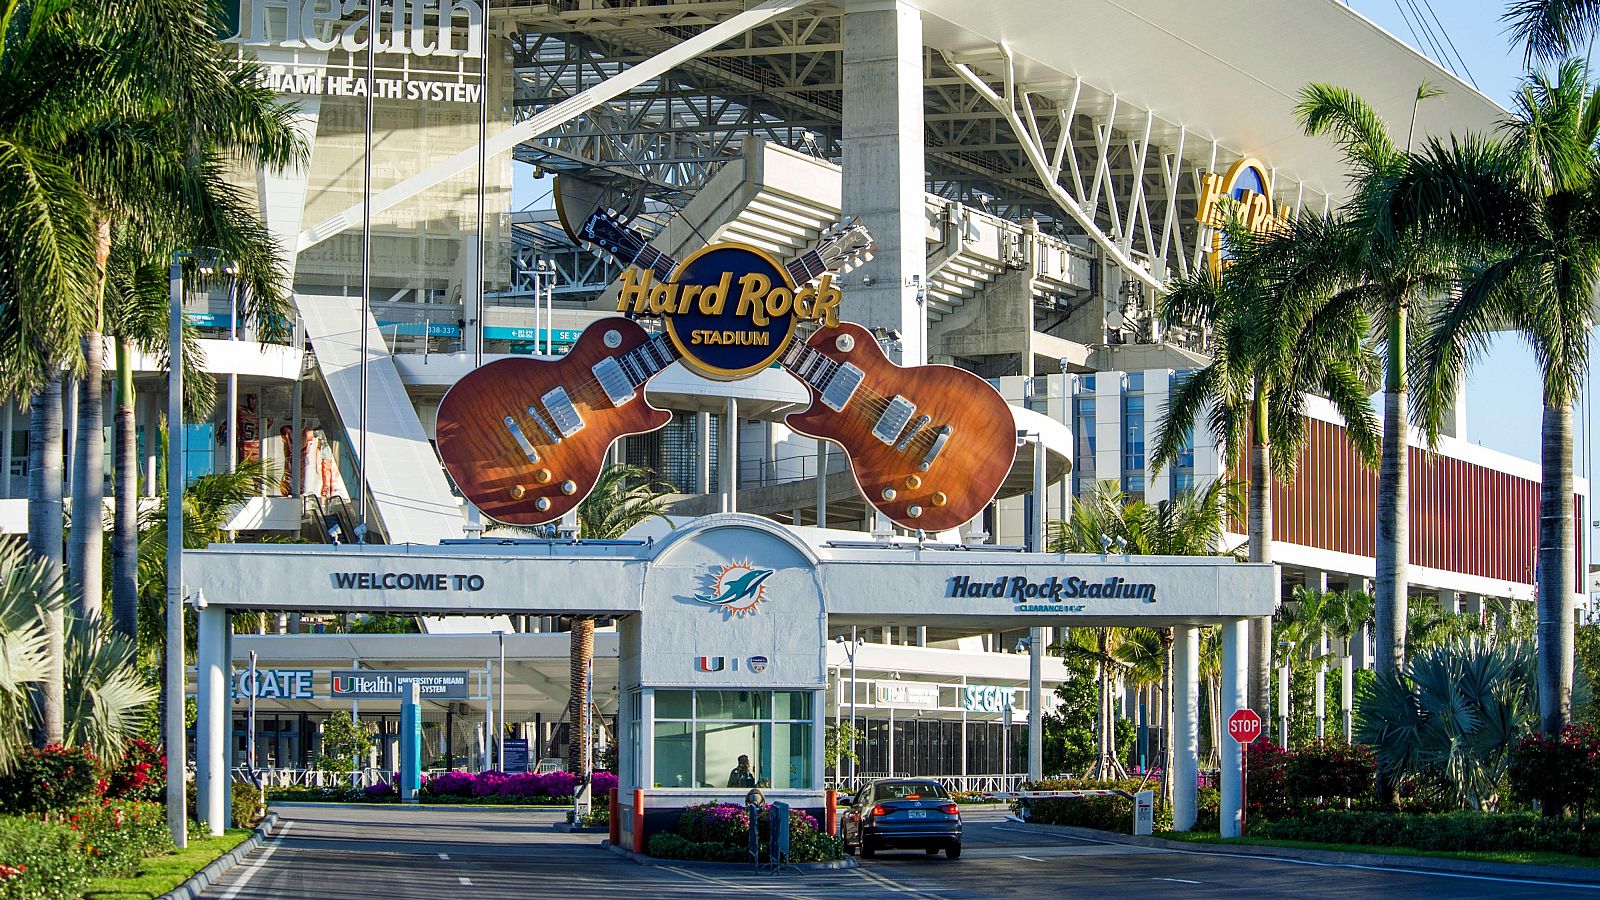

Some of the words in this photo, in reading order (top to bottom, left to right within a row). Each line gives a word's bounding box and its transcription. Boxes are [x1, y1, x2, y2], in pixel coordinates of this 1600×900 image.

[257, 72, 322, 96] MIAMI
[327, 75, 402, 99] HEALTH
[407, 80, 482, 103] SYSTEM
[617, 267, 733, 315] Hard
[735, 272, 843, 328] Rock
[559, 331, 570, 339] SE
[690, 329, 770, 346] STADIUM
[334, 572, 448, 591] WELCOME
[454, 574, 485, 592] TO
[951, 576, 1009, 598] Hard
[1010, 576, 1063, 603] Rock
[1064, 576, 1157, 603] Stadium
[239, 670, 312, 698] GATE
[333, 676, 393, 694] UHealth
[397, 677, 433, 685] UNIVERSITY
[434, 677, 443, 685] OF
[443, 677, 464, 685] MIAMI
[421, 685, 446, 693] SYSTEM
[965, 685, 983, 712] SE
[984, 686, 1016, 712] GATE
[1230, 719, 1259, 733] STOP
